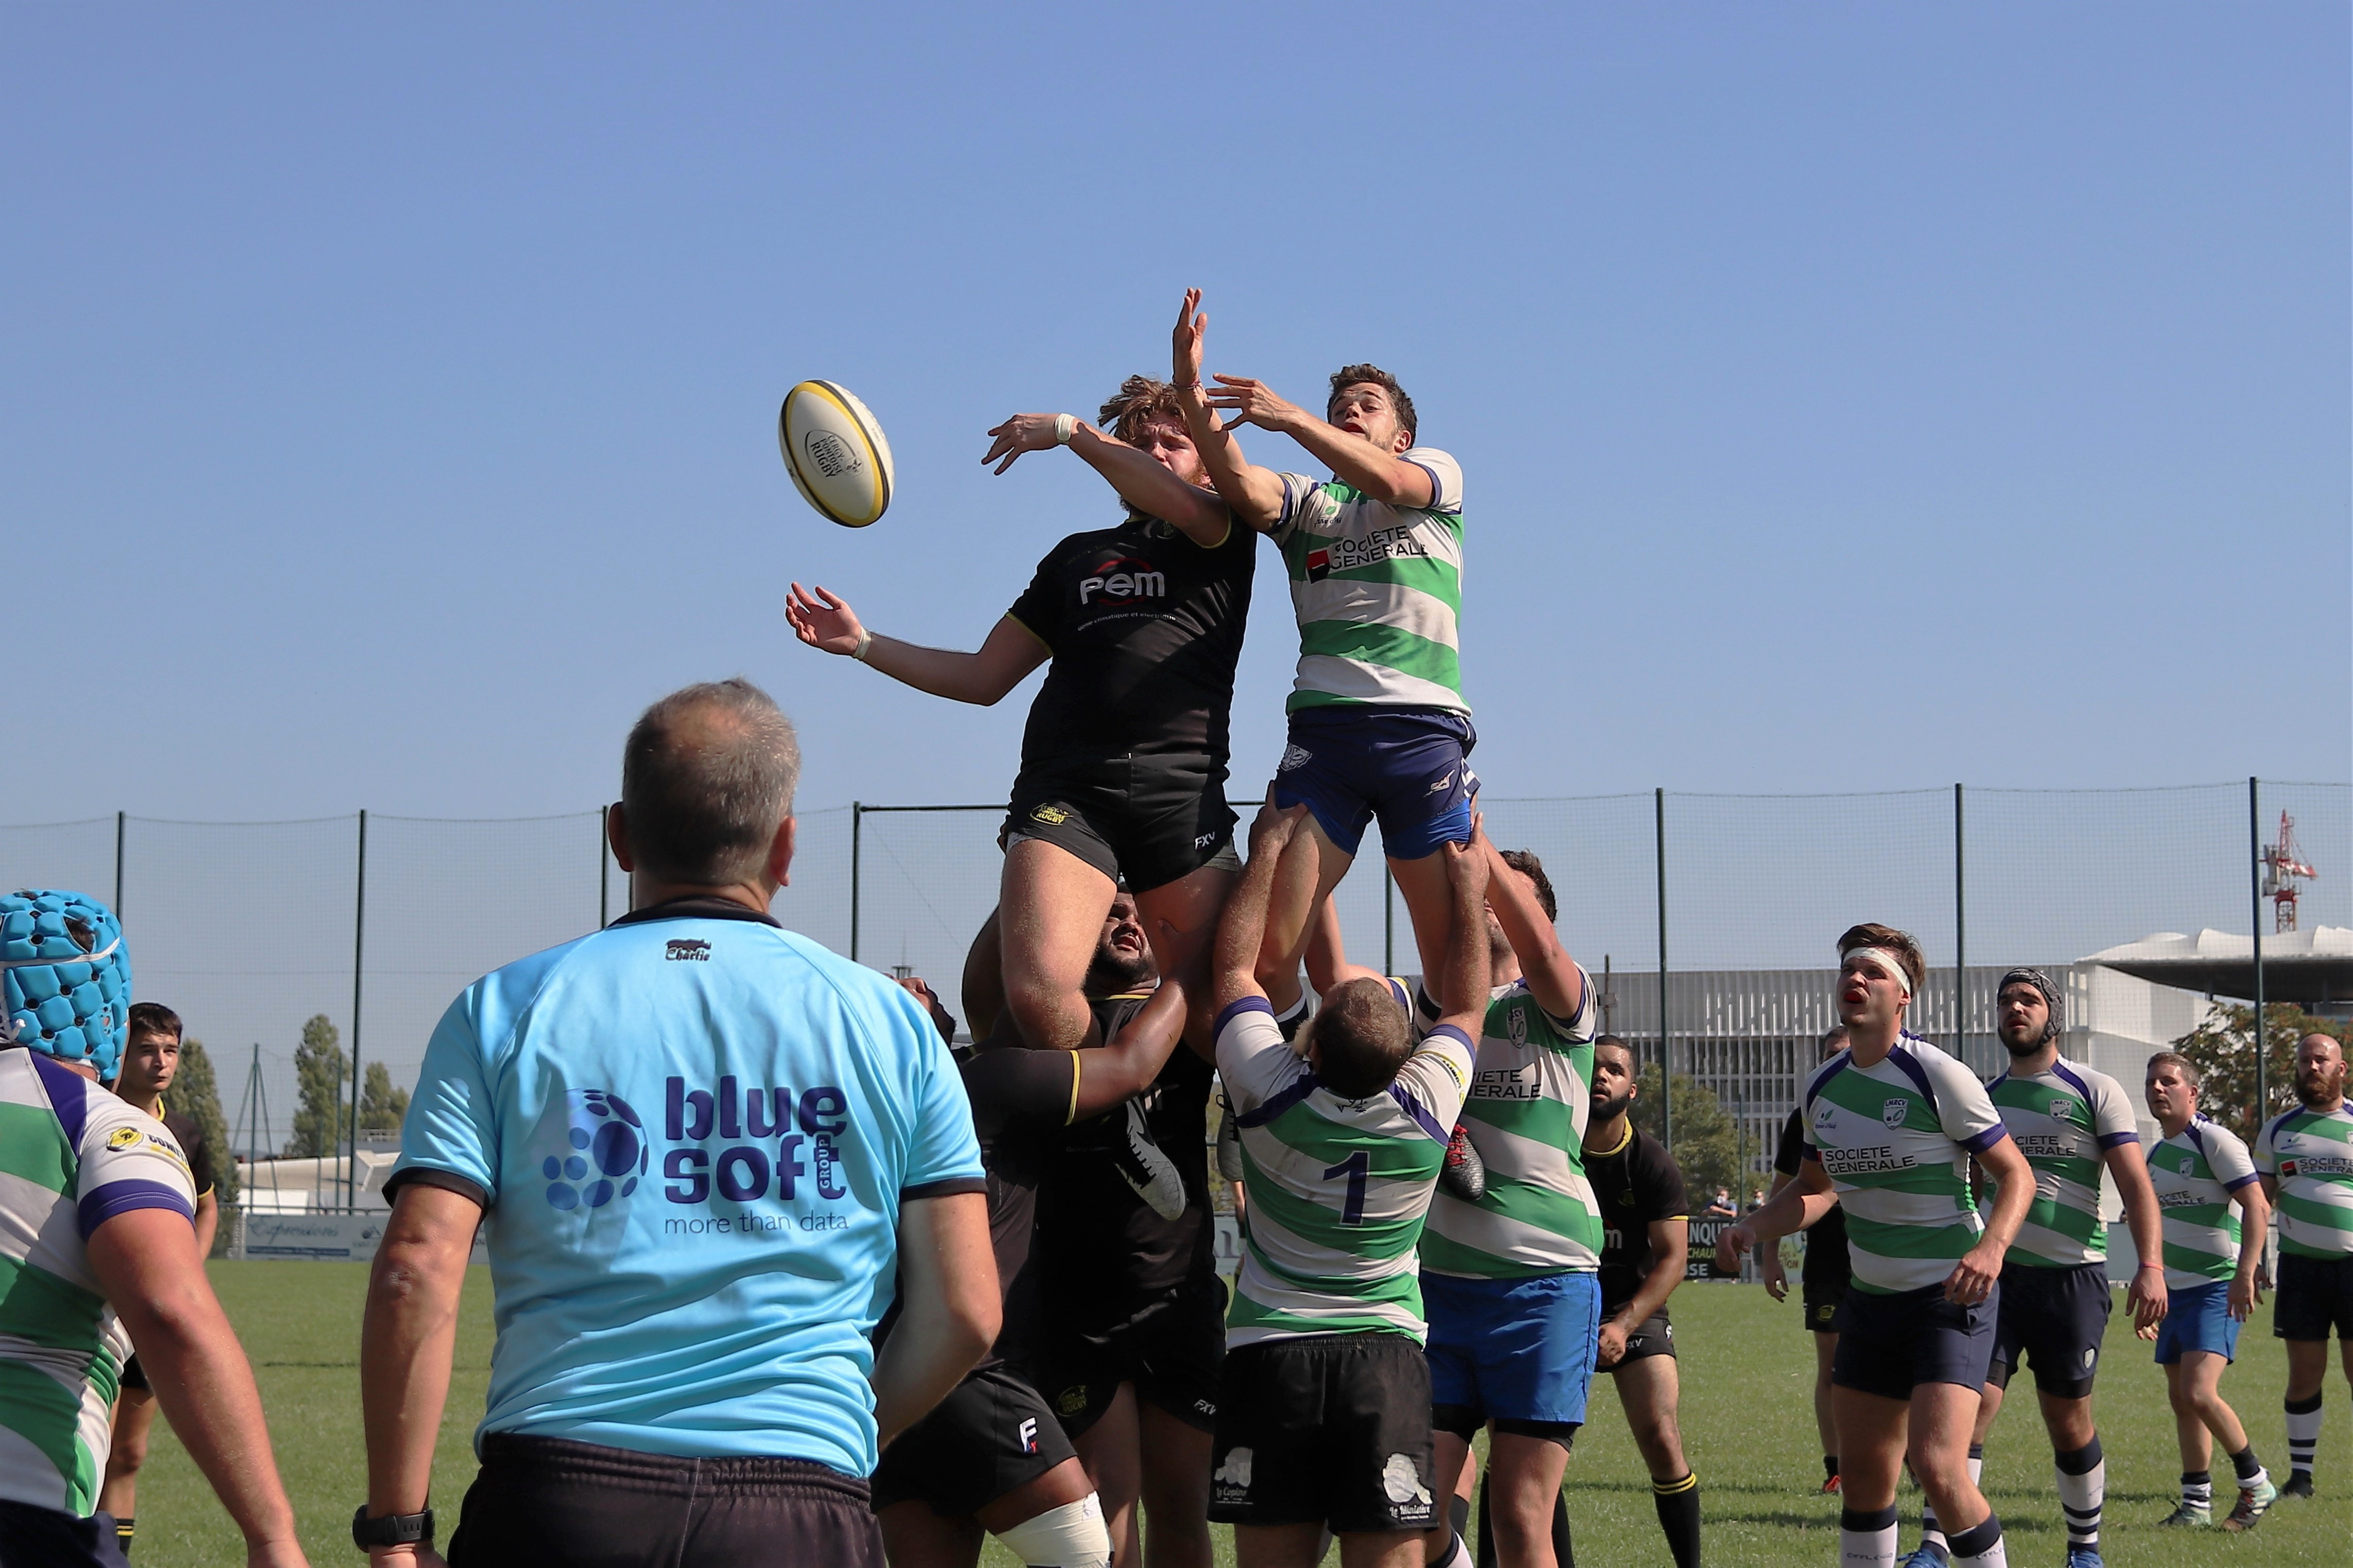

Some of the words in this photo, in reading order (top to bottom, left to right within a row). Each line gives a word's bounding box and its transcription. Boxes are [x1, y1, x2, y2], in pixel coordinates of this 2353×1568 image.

[810, 442, 837, 478] RUGBY
[820, 438, 844, 474] PONTOISE
[1094, 613, 1129, 623] climatique
[1036, 813, 1065, 824] RUGBY
[1195, 831, 1215, 850] FXV
[665, 947, 710, 961] Charlie
[1474, 1069, 1523, 1083] IETE
[1470, 1083, 1541, 1099] ERALE
[666, 1075, 847, 1140] blue
[2012, 1136, 2059, 1145] CIETE
[1825, 1146, 1892, 1161] SOCIETE
[664, 1134, 847, 1204] soft
[820, 1139, 829, 1188] GROUP
[1828, 1156, 1916, 1174] GENERALE
[1322, 1151, 1370, 1225] 1
[665, 1218, 730, 1234] more
[739, 1210, 791, 1231] than
[800, 1210, 849, 1231] data
